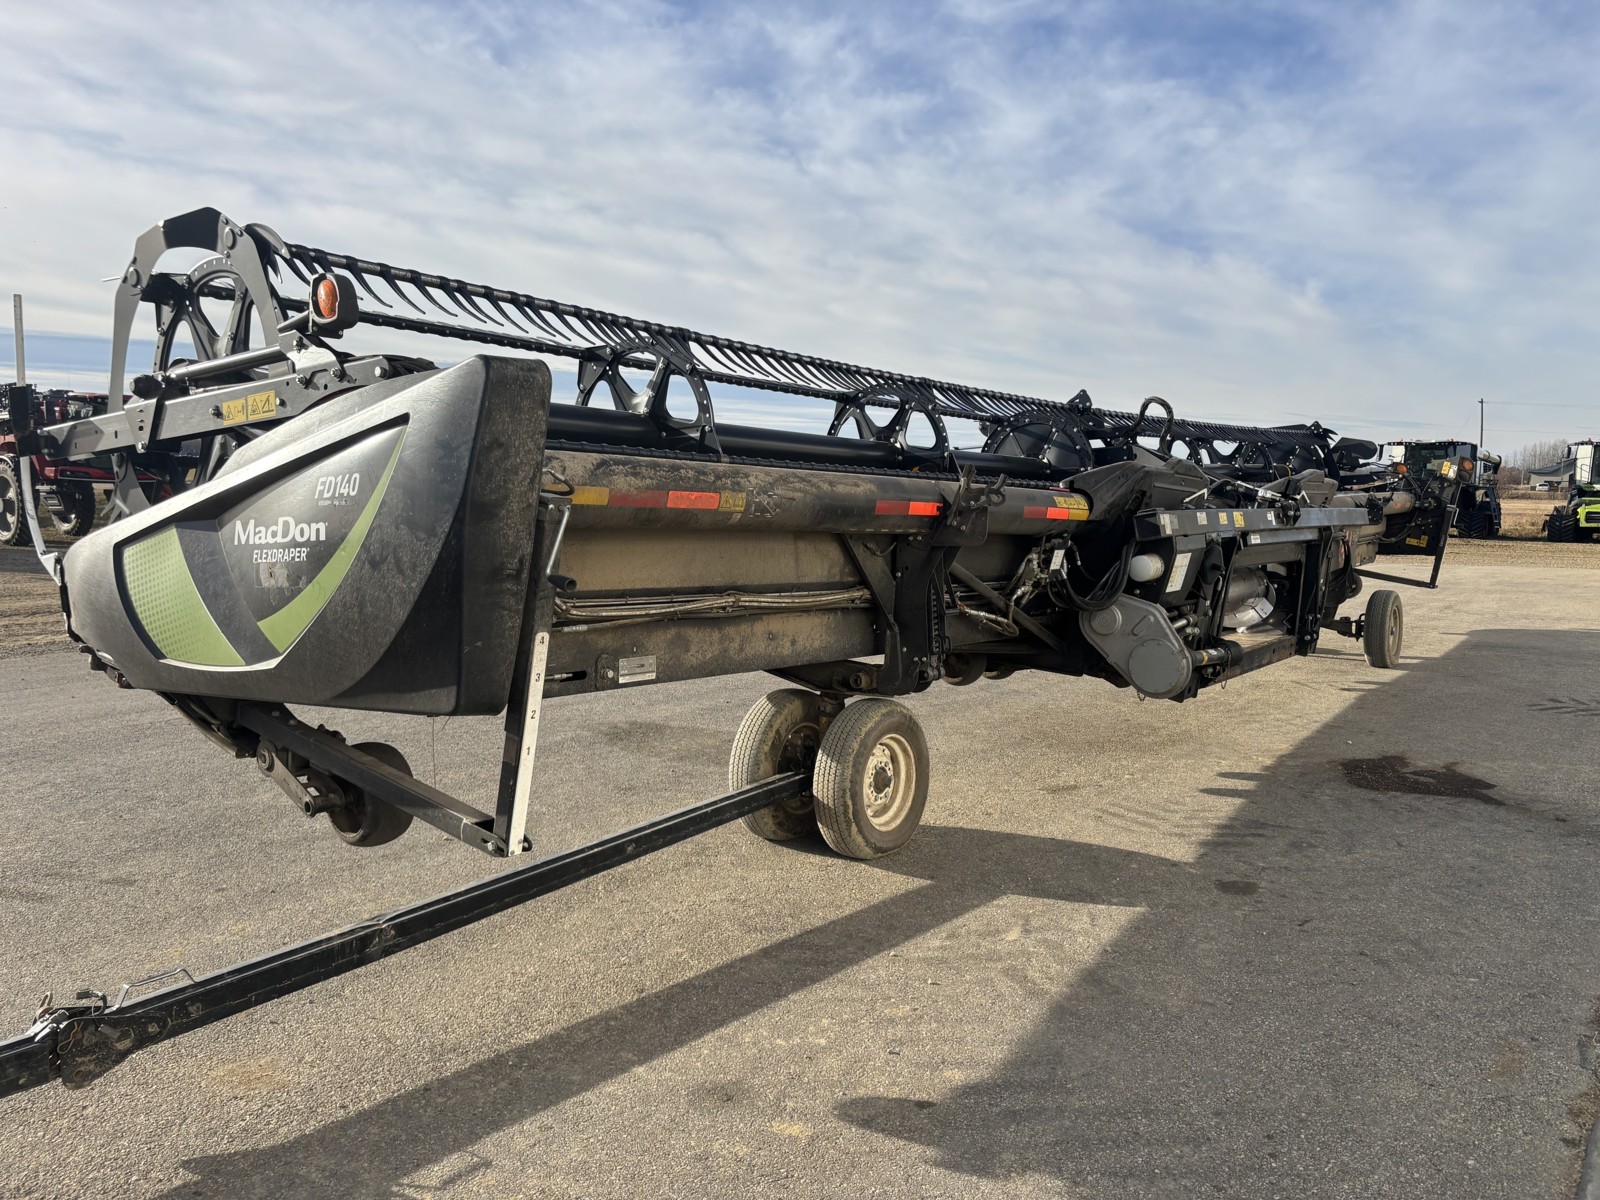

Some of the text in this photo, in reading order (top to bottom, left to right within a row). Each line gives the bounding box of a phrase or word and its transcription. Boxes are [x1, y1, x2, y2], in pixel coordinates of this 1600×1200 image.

[315, 473, 360, 499] FD140
[234, 516, 326, 545] MacDon
[253, 548, 308, 563] FLEXDRAPER
[539, 635, 545, 645] 4
[535, 673, 541, 682] 3
[530, 710, 536, 719] 2
[526, 746, 531, 756] 1
